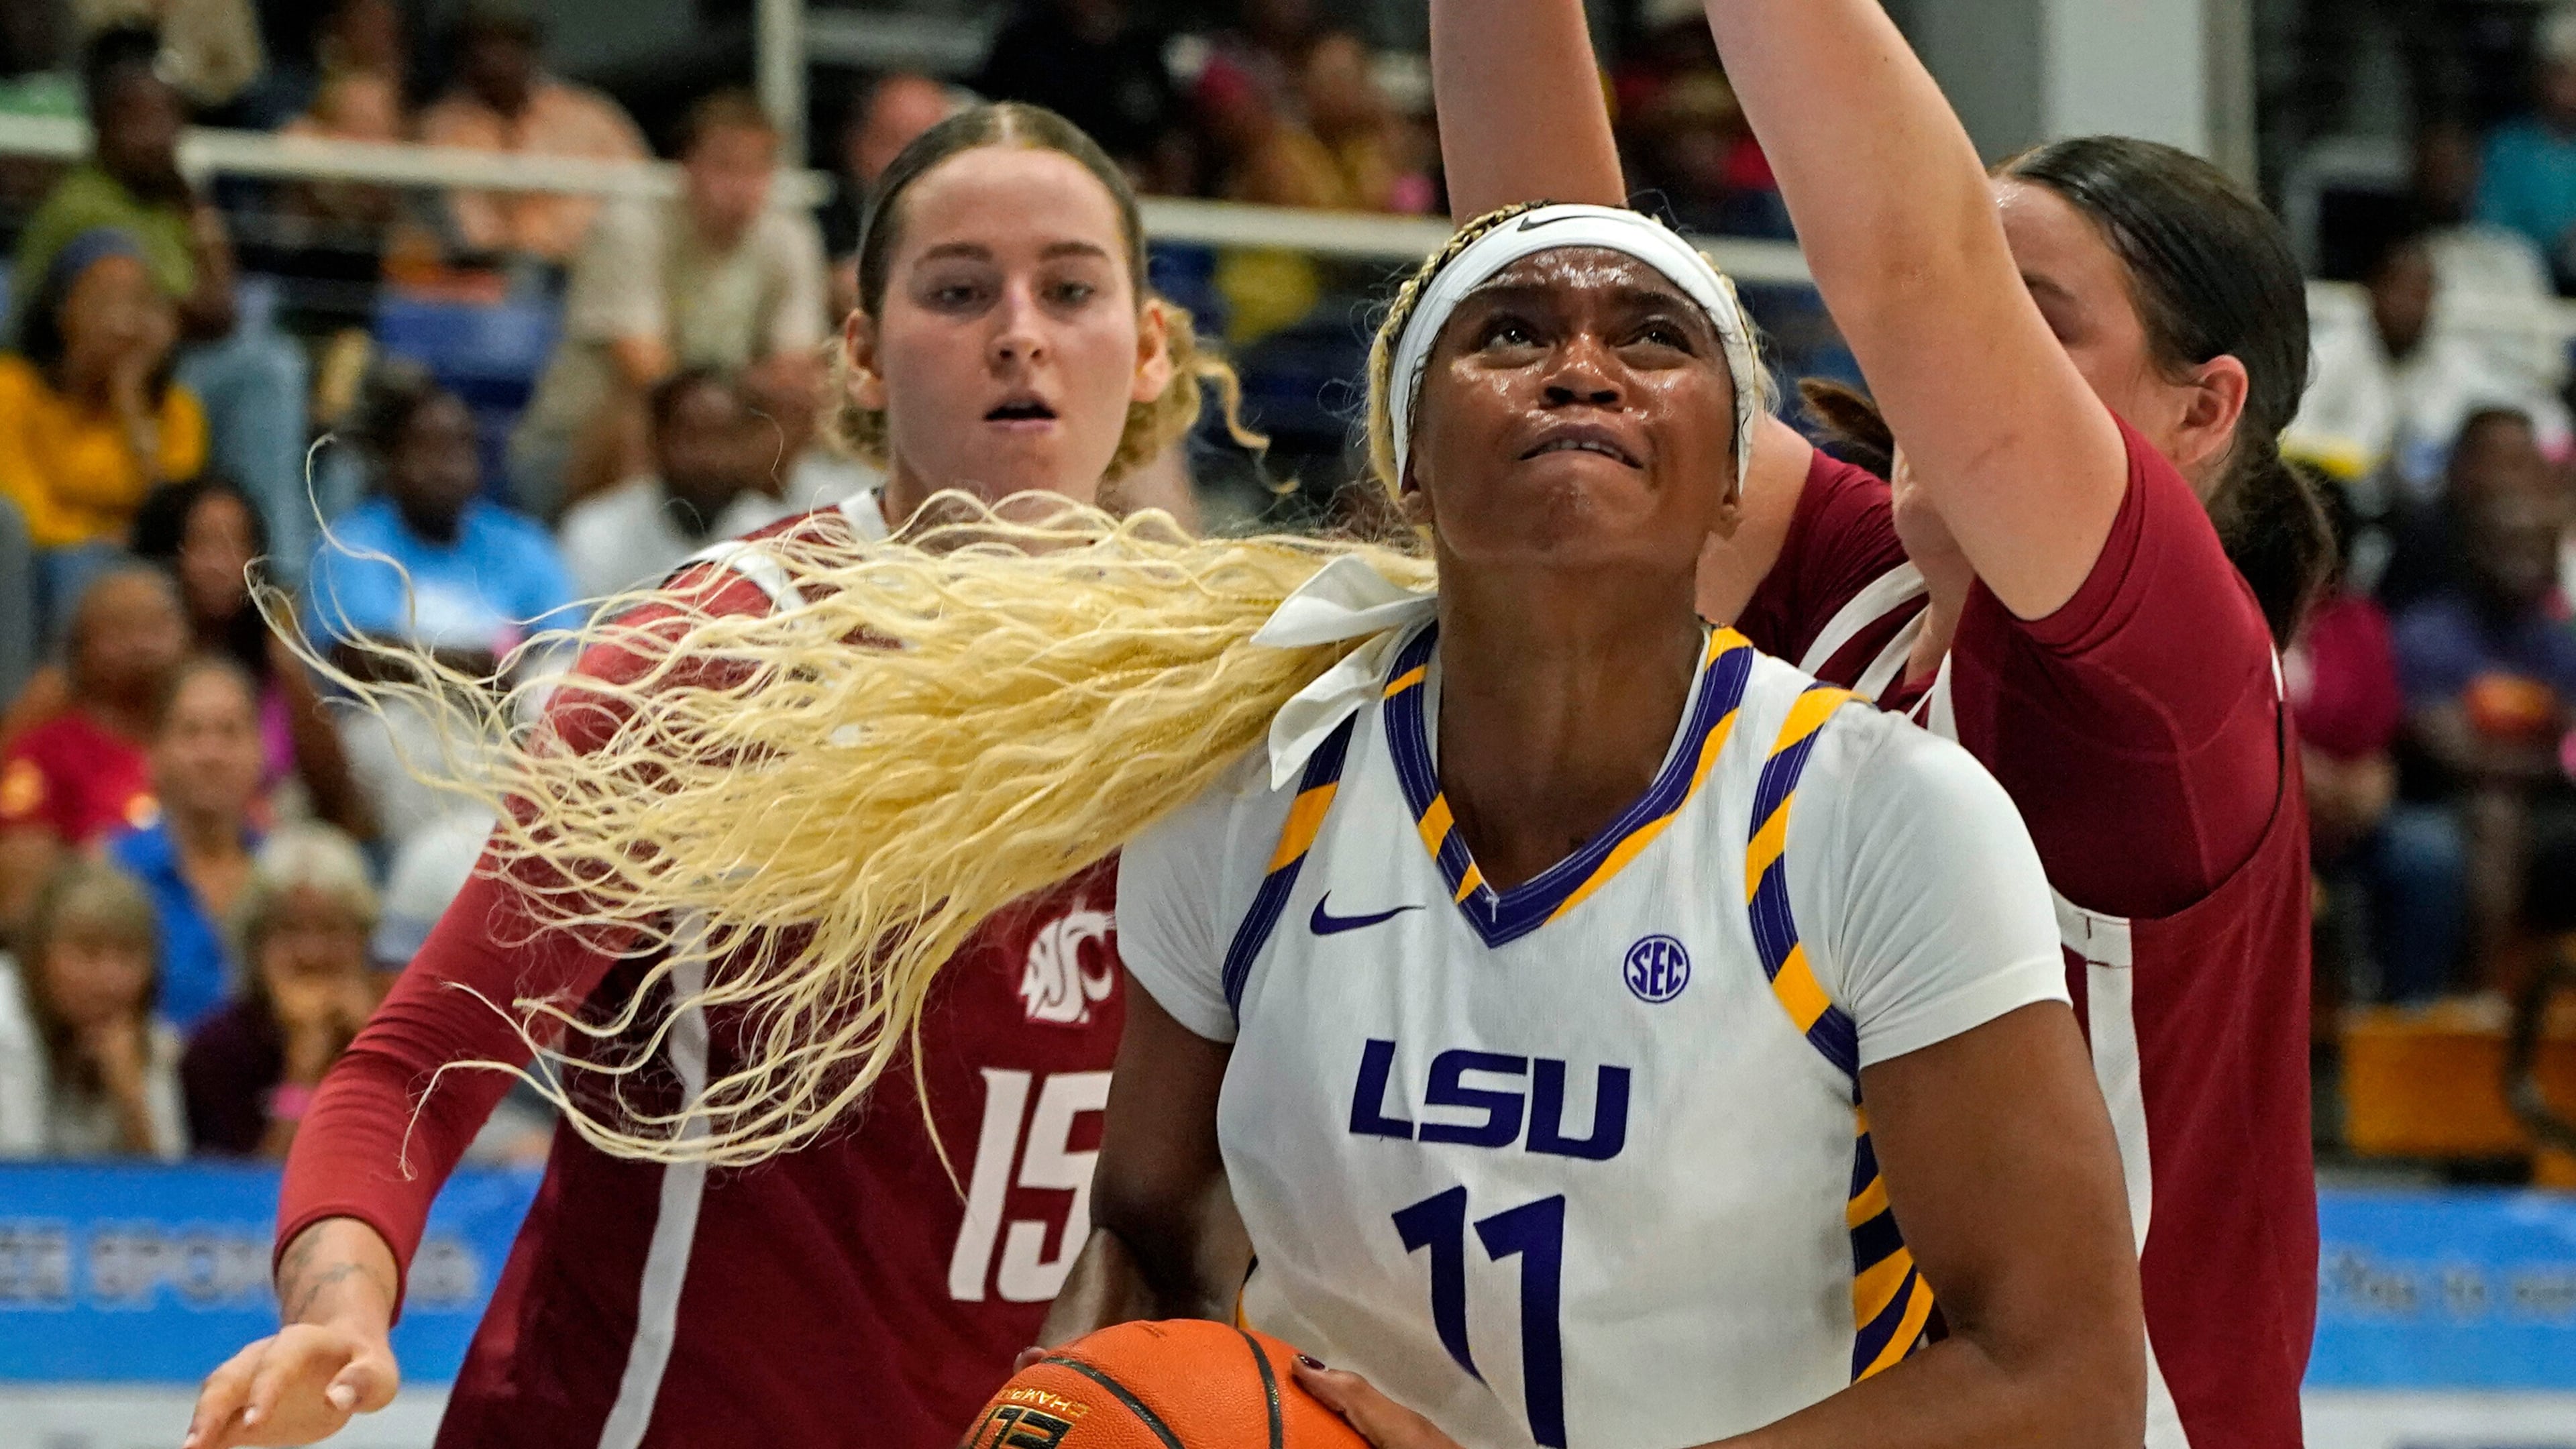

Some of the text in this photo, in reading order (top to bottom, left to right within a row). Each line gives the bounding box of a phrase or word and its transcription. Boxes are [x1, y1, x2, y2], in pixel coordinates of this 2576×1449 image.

[1631, 941, 1684, 996] SEC
[948, 1067, 1114, 1303] 15
[1350, 1038, 1631, 1161] LSU
[1391, 1185, 1566, 1449] 11
